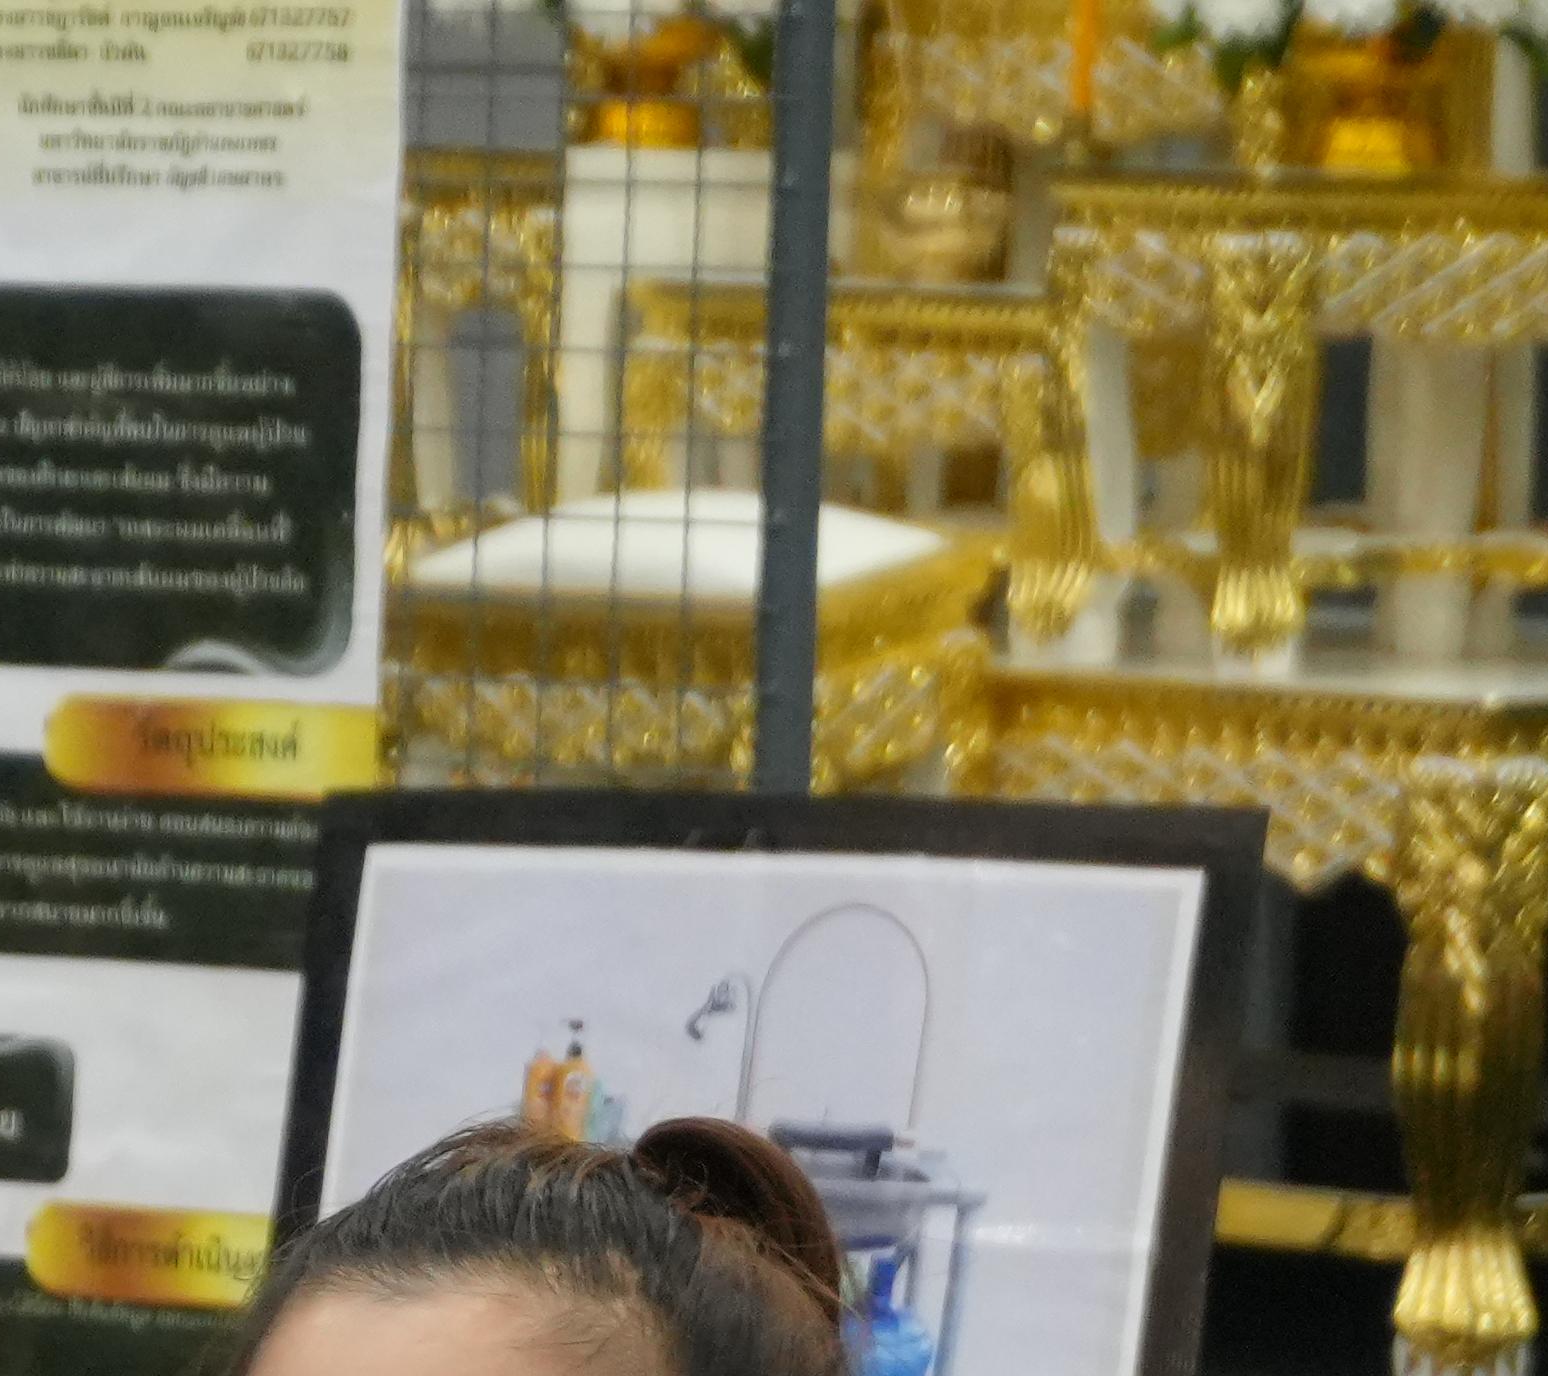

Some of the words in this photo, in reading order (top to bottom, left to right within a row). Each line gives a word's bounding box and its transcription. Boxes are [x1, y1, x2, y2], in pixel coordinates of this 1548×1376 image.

[134, 712, 300, 768] วัตถุประสงค์
